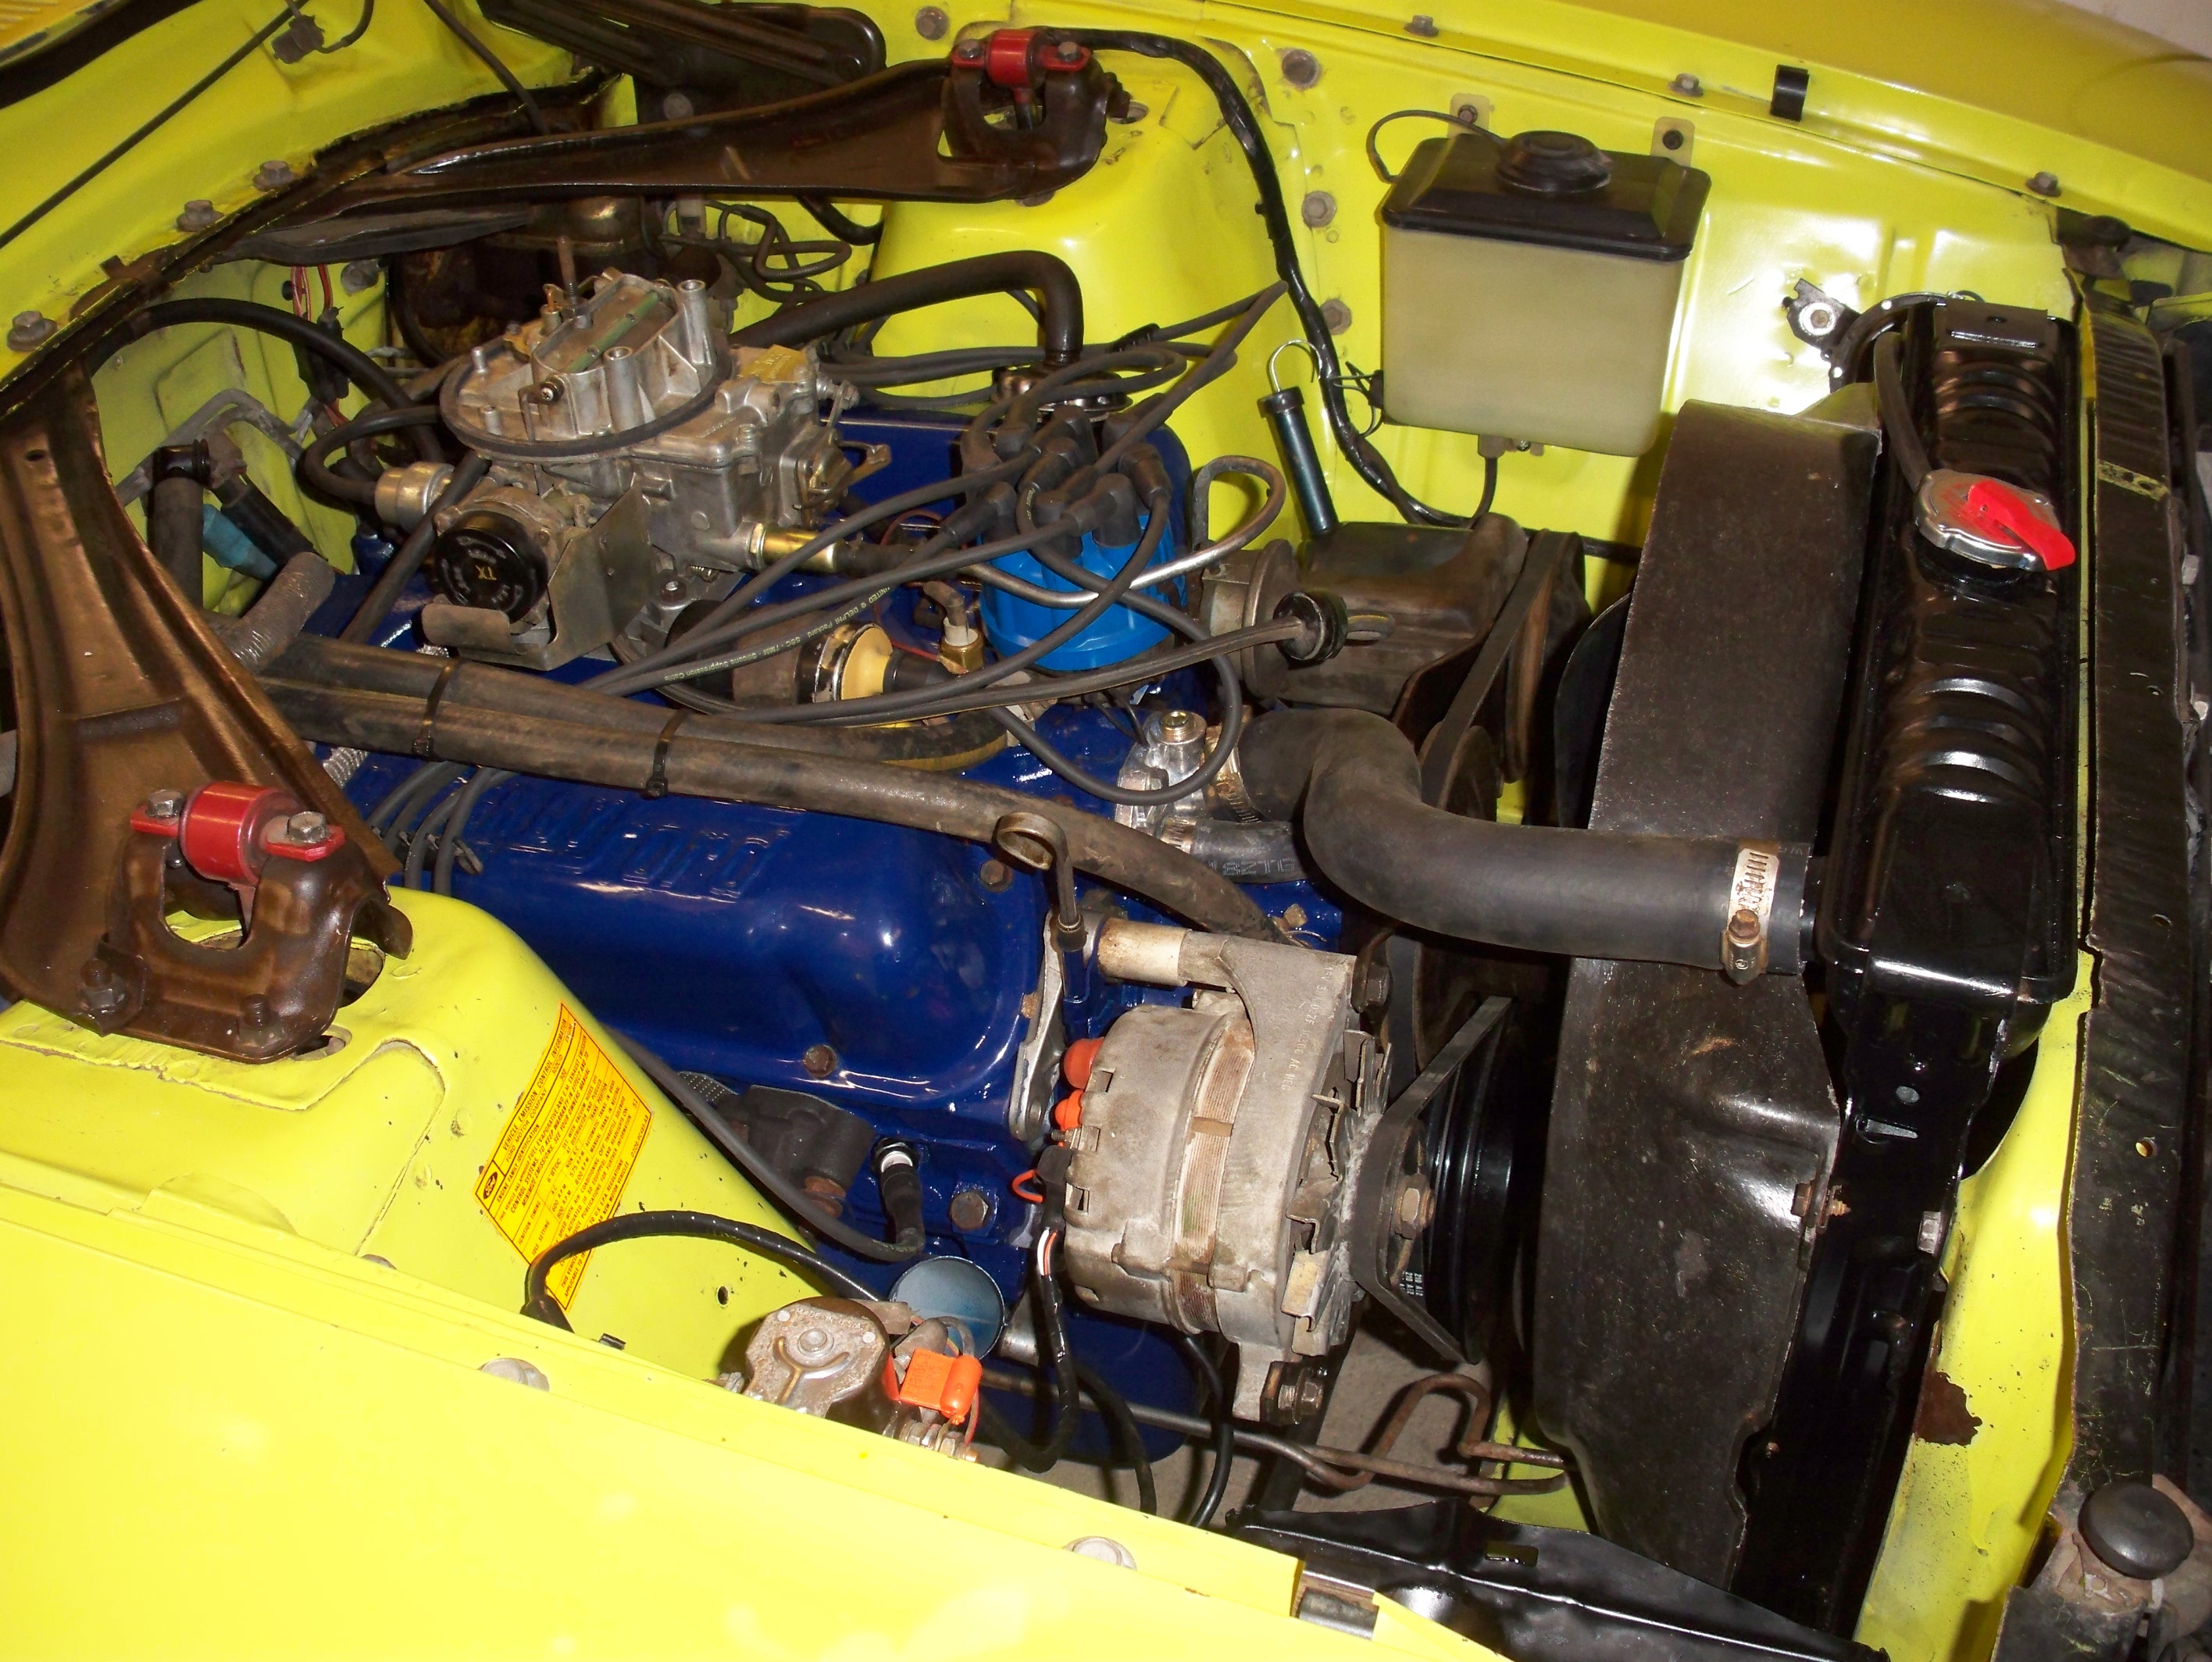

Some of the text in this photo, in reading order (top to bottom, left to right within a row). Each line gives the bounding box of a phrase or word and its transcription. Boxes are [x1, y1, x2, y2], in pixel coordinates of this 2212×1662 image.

[784, 635, 801, 647] SSC
[806, 620, 833, 638] Packard
[833, 605, 859, 625] DELPHI
[663, 671, 685, 682] Cable
[685, 658, 729, 677] Suppression
[501, 1016, 567, 1152] VEHICLE EMISSION CONTROL INFORMATION
[504, 1191, 516, 1211] VEHICLE
[518, 1159, 530, 1182] APPROVED
[527, 1144, 538, 1162] FUEL
[536, 1107, 558, 1147] EVAPORATIVE
[555, 1094, 565, 1111] AND
[567, 1057, 580, 1084] EXHAUST
[577, 1033, 587, 1060] EMISSION
[505, 1143, 516, 1164] FORD
[514, 1118, 530, 1144] MOTOR
[529, 1086, 548, 1120] COMPANY
[565, 1155, 573, 1169] NON
[596, 1081, 608, 1104] POSITION
[569, 1112, 587, 1147] DISTRIBUTOR
[496, 1067, 567, 1204] ENGINE FAMILY IDENTIFICATION 302
[509, 1184, 526, 1214] CONTROL
[538, 1143, 546, 1156] TO
[543, 1129, 555, 1147] KEEP
[552, 1097, 570, 1131] WARRANTY
[570, 1069, 582, 1093] EFFECT
[578, 1057, 587, 1073] AND
[518, 1219, 532, 1246] IGNITION
[530, 1198, 541, 1220] TIMING
[567, 1123, 576, 1140] WITH
[574, 1101, 587, 1124] VACUUM
[584, 1083, 594, 1102] HOSES
[520, 1176, 537, 1208] MINIMIZE
[552, 1130, 561, 1145] SEE
[558, 1113, 569, 1132] YOUR
[566, 1089, 581, 1116] OWNERS
[551, 1198, 559, 1213] 600
[569, 1163, 578, 1179] 575
[584, 1118, 600, 1148] AUTOMATIC
[558, 1220, 567, 1238] SPEED
[565, 1204, 574, 1221] WITH
[579, 1156, 600, 1194] CONDITIONING
[604, 1118, 616, 1143] THROTTLE
[614, 1094, 626, 1119] SOLENOID
[567, 1204, 583, 1233] ACTIVATED
[610, 1115, 624, 1146] HEADLIGHTS
[573, 1169, 583, 1186] 800
[589, 1132, 601, 1154] MANUAL
[610, 1085, 620, 1106] NEUTRAL
[580, 1182, 601, 1220] PUBLICATIONS
[605, 1146, 618, 1171] FURTHER
[615, 1113, 632, 1147] INFORMATION
[537, 1218, 550, 1243] SETTING
[560, 1274, 569, 1289] THIS
[606, 1157, 623, 1193] REGULATIONS
[563, 1265, 579, 1298] APPLICABLE
[601, 1201, 610, 1215] NEW
[608, 1182, 619, 1203] MOTOR
[616, 1160, 630, 1185] VEHICLES
[794, 1306, 821, 1320] MADE
[824, 1314, 834, 1323] IN
